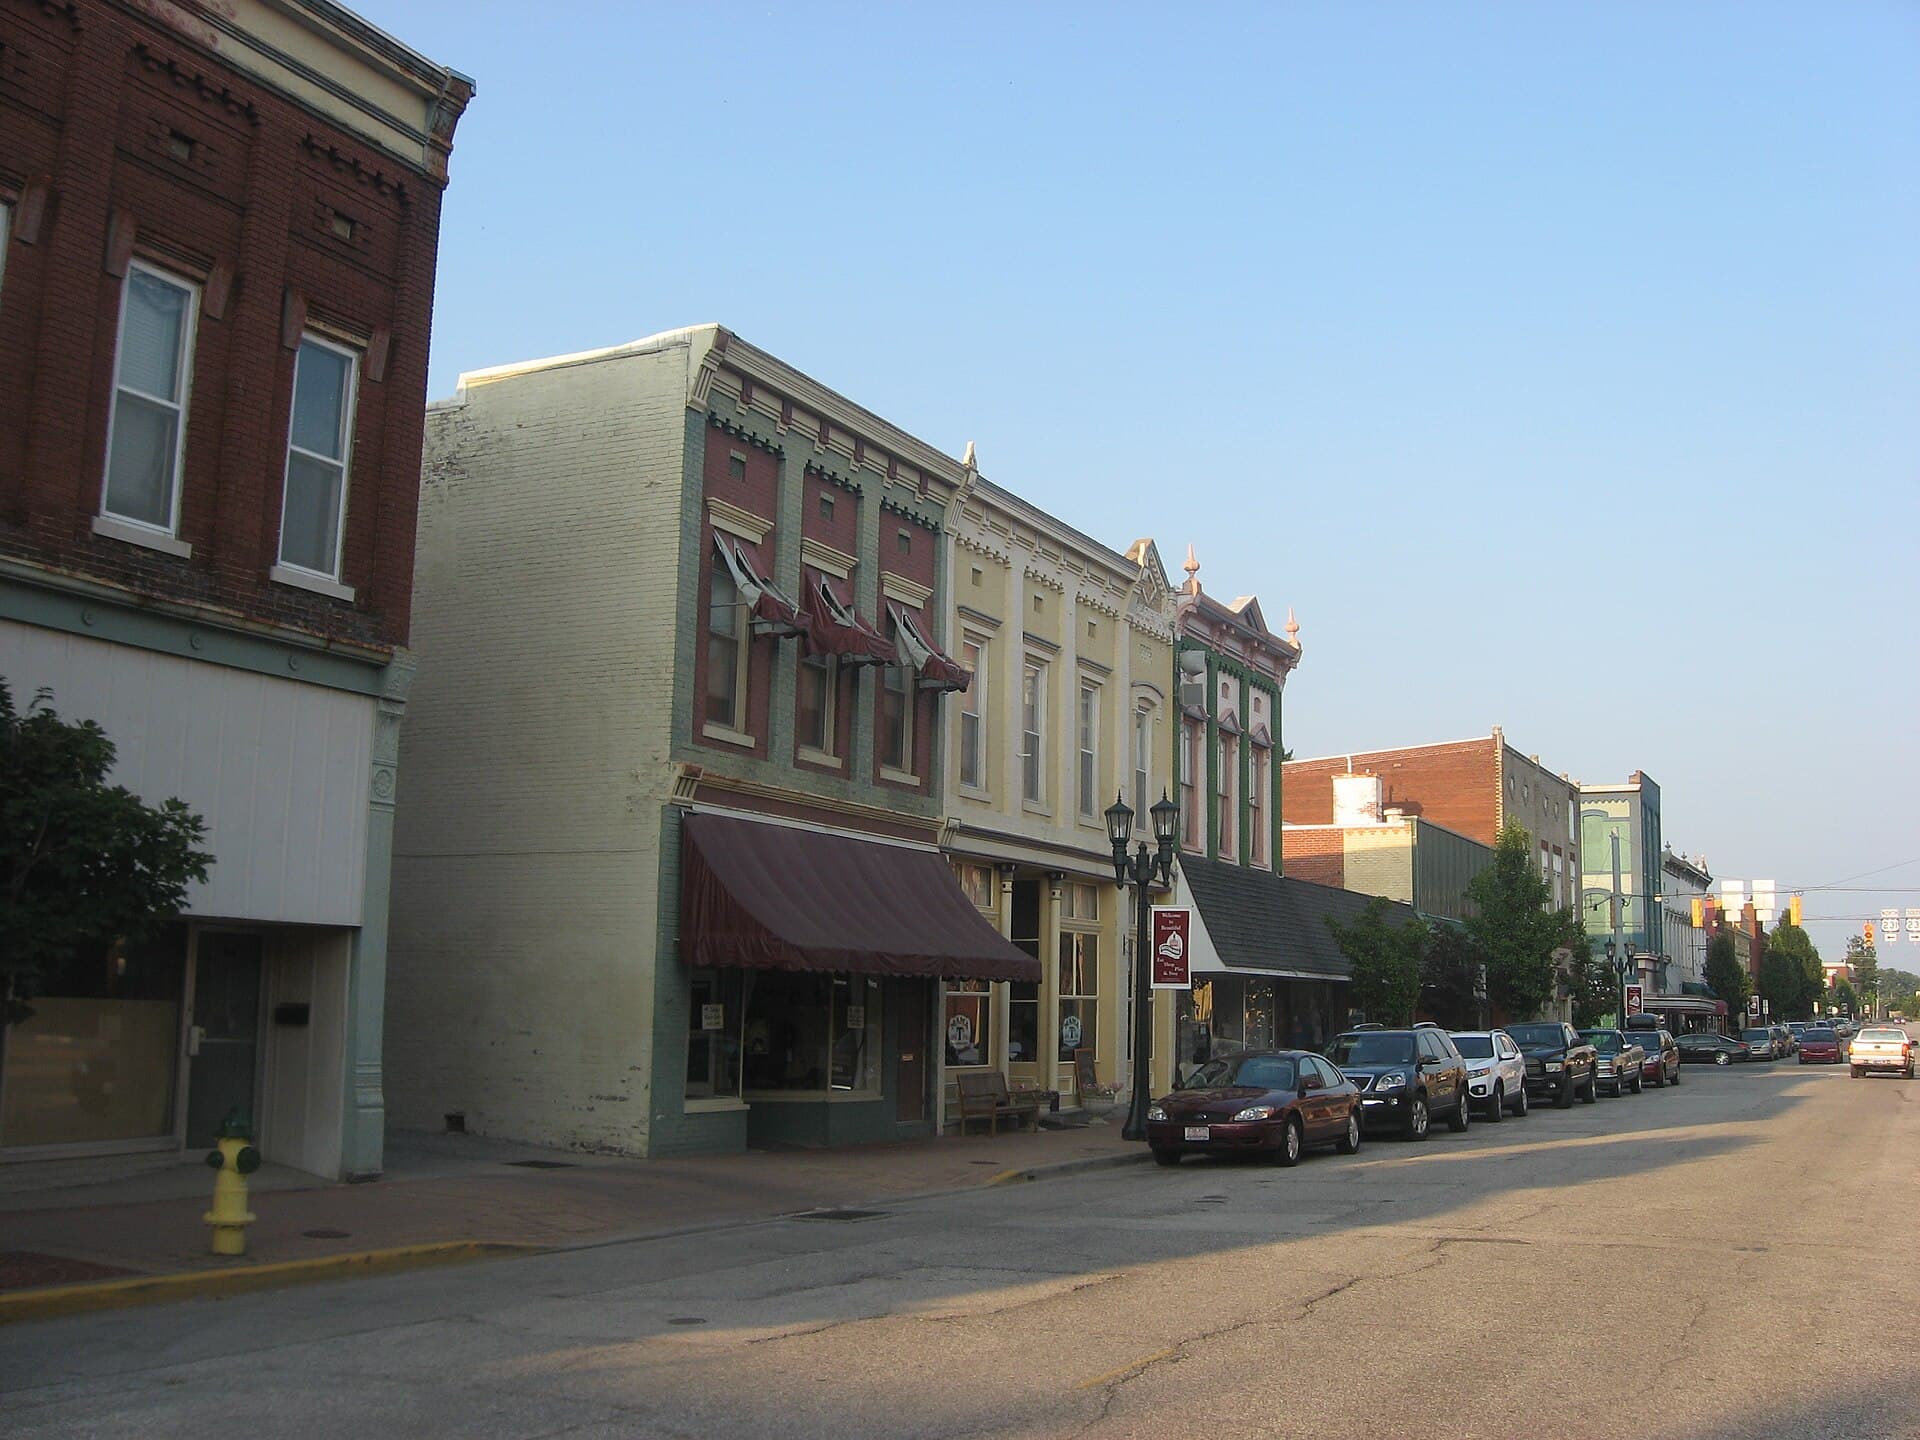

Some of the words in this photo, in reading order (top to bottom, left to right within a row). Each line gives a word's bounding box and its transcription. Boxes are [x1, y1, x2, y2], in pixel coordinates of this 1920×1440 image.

[1882, 921, 1898, 929] 231
[955, 1026, 965, 1039] T
[1068, 1025, 1077, 1037] T
